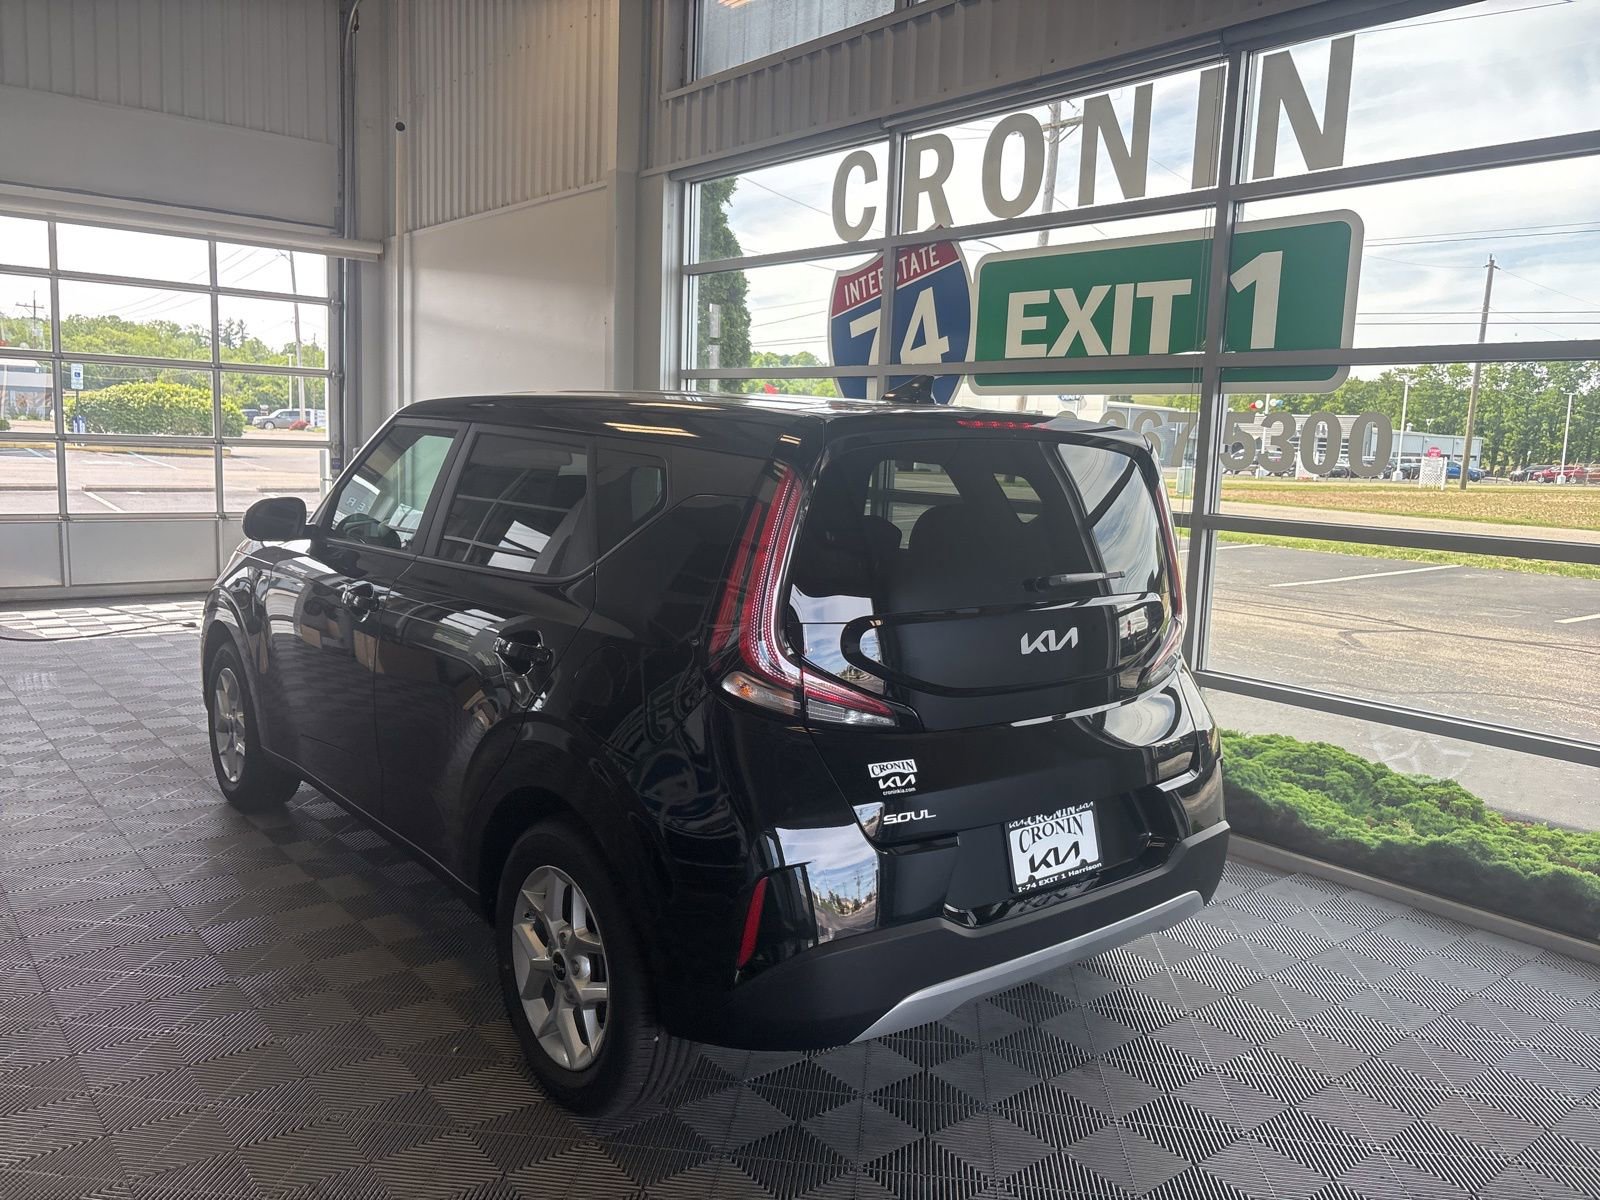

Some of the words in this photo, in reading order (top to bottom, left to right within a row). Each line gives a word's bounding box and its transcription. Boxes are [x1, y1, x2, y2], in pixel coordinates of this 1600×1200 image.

[832, 35, 1355, 242] CRONIN
[1005, 279, 1192, 359] EXIT
[1230, 250, 1282, 349] 1
[1020, 626, 1079, 655] KIA
[871, 761, 915, 776] CRONIN
[879, 774, 916, 789] KIA
[883, 788, 916, 796] croninkia.com
[883, 809, 937, 825] SOUL
[1019, 814, 1085, 853] CRONIN
[1029, 840, 1081, 873] KIA
[1018, 883, 1037, 893] I-74
[1038, 876, 1060, 887] EXIT
[1068, 862, 1102, 877] Harrison
